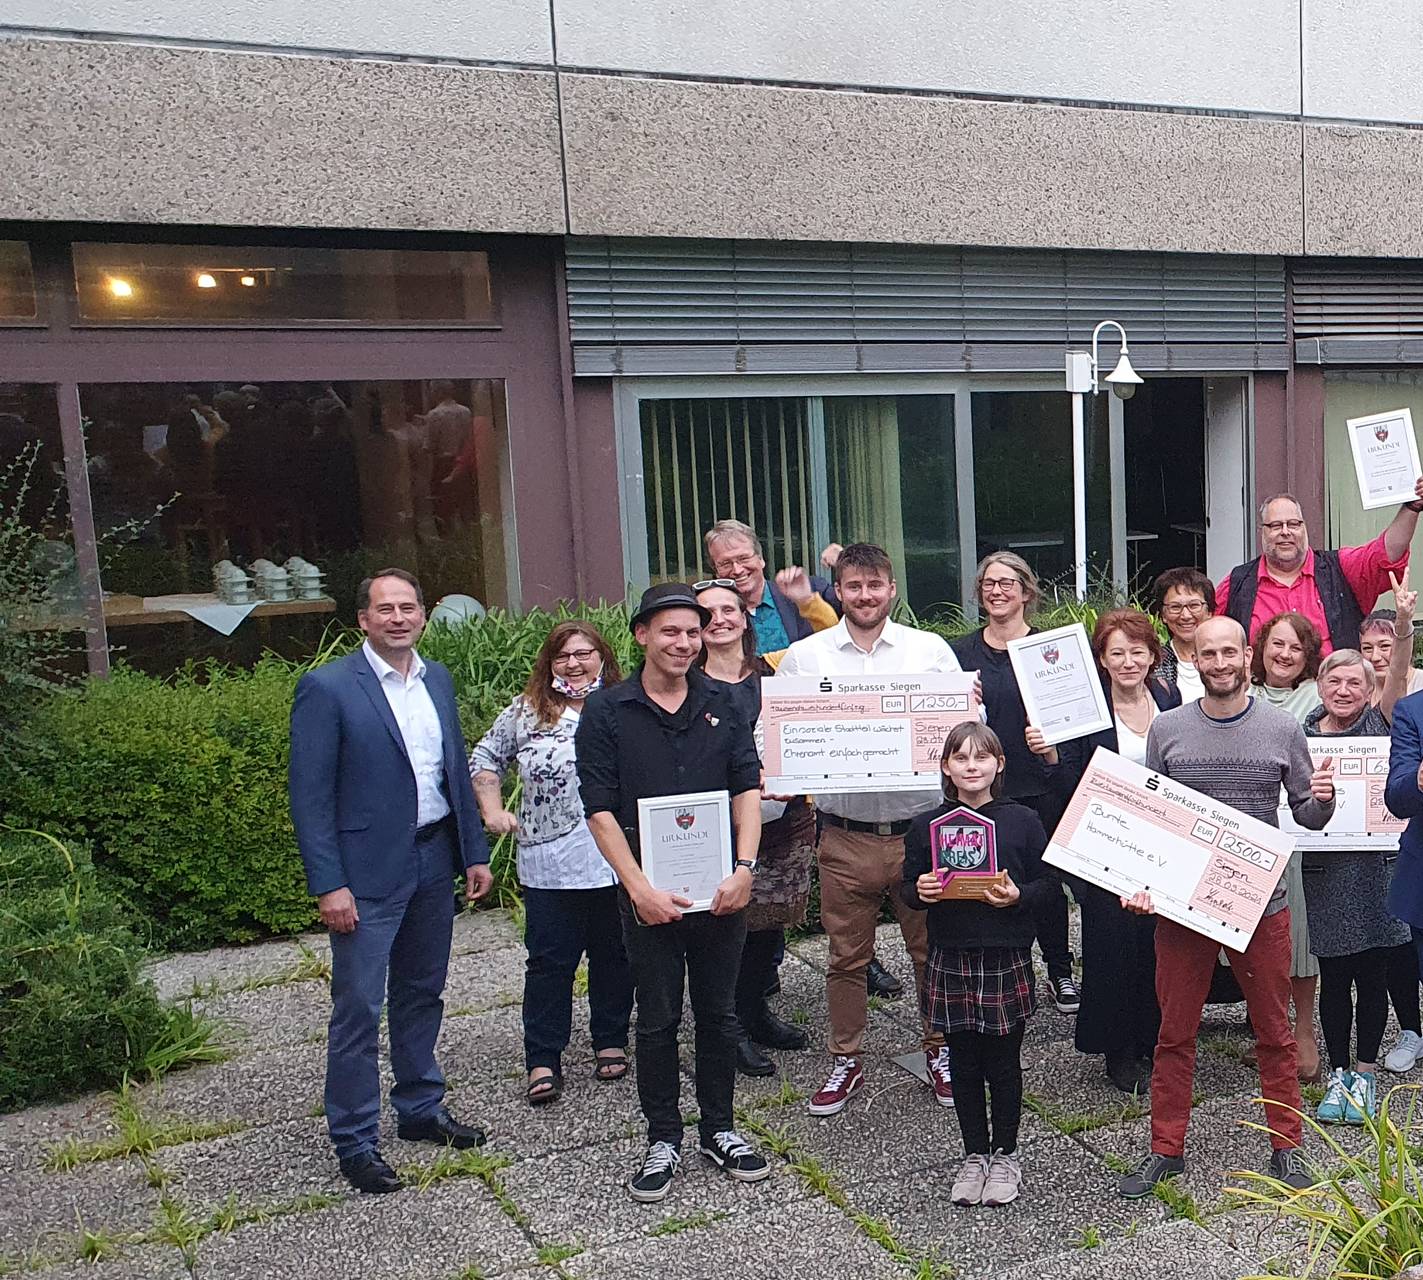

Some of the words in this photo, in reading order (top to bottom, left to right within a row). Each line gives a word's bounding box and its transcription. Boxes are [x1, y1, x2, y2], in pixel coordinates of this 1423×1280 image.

[838, 683, 885, 693] Sparkasse
[890, 682, 921, 692] Siegen
[1348, 745, 1377, 755] Siegen
[1162, 787, 1207, 815] Sparkasse
[1210, 810, 1240, 830] Siegen
[1091, 803, 1130, 830] Bunte
[1197, 825, 1213, 837] EUR
